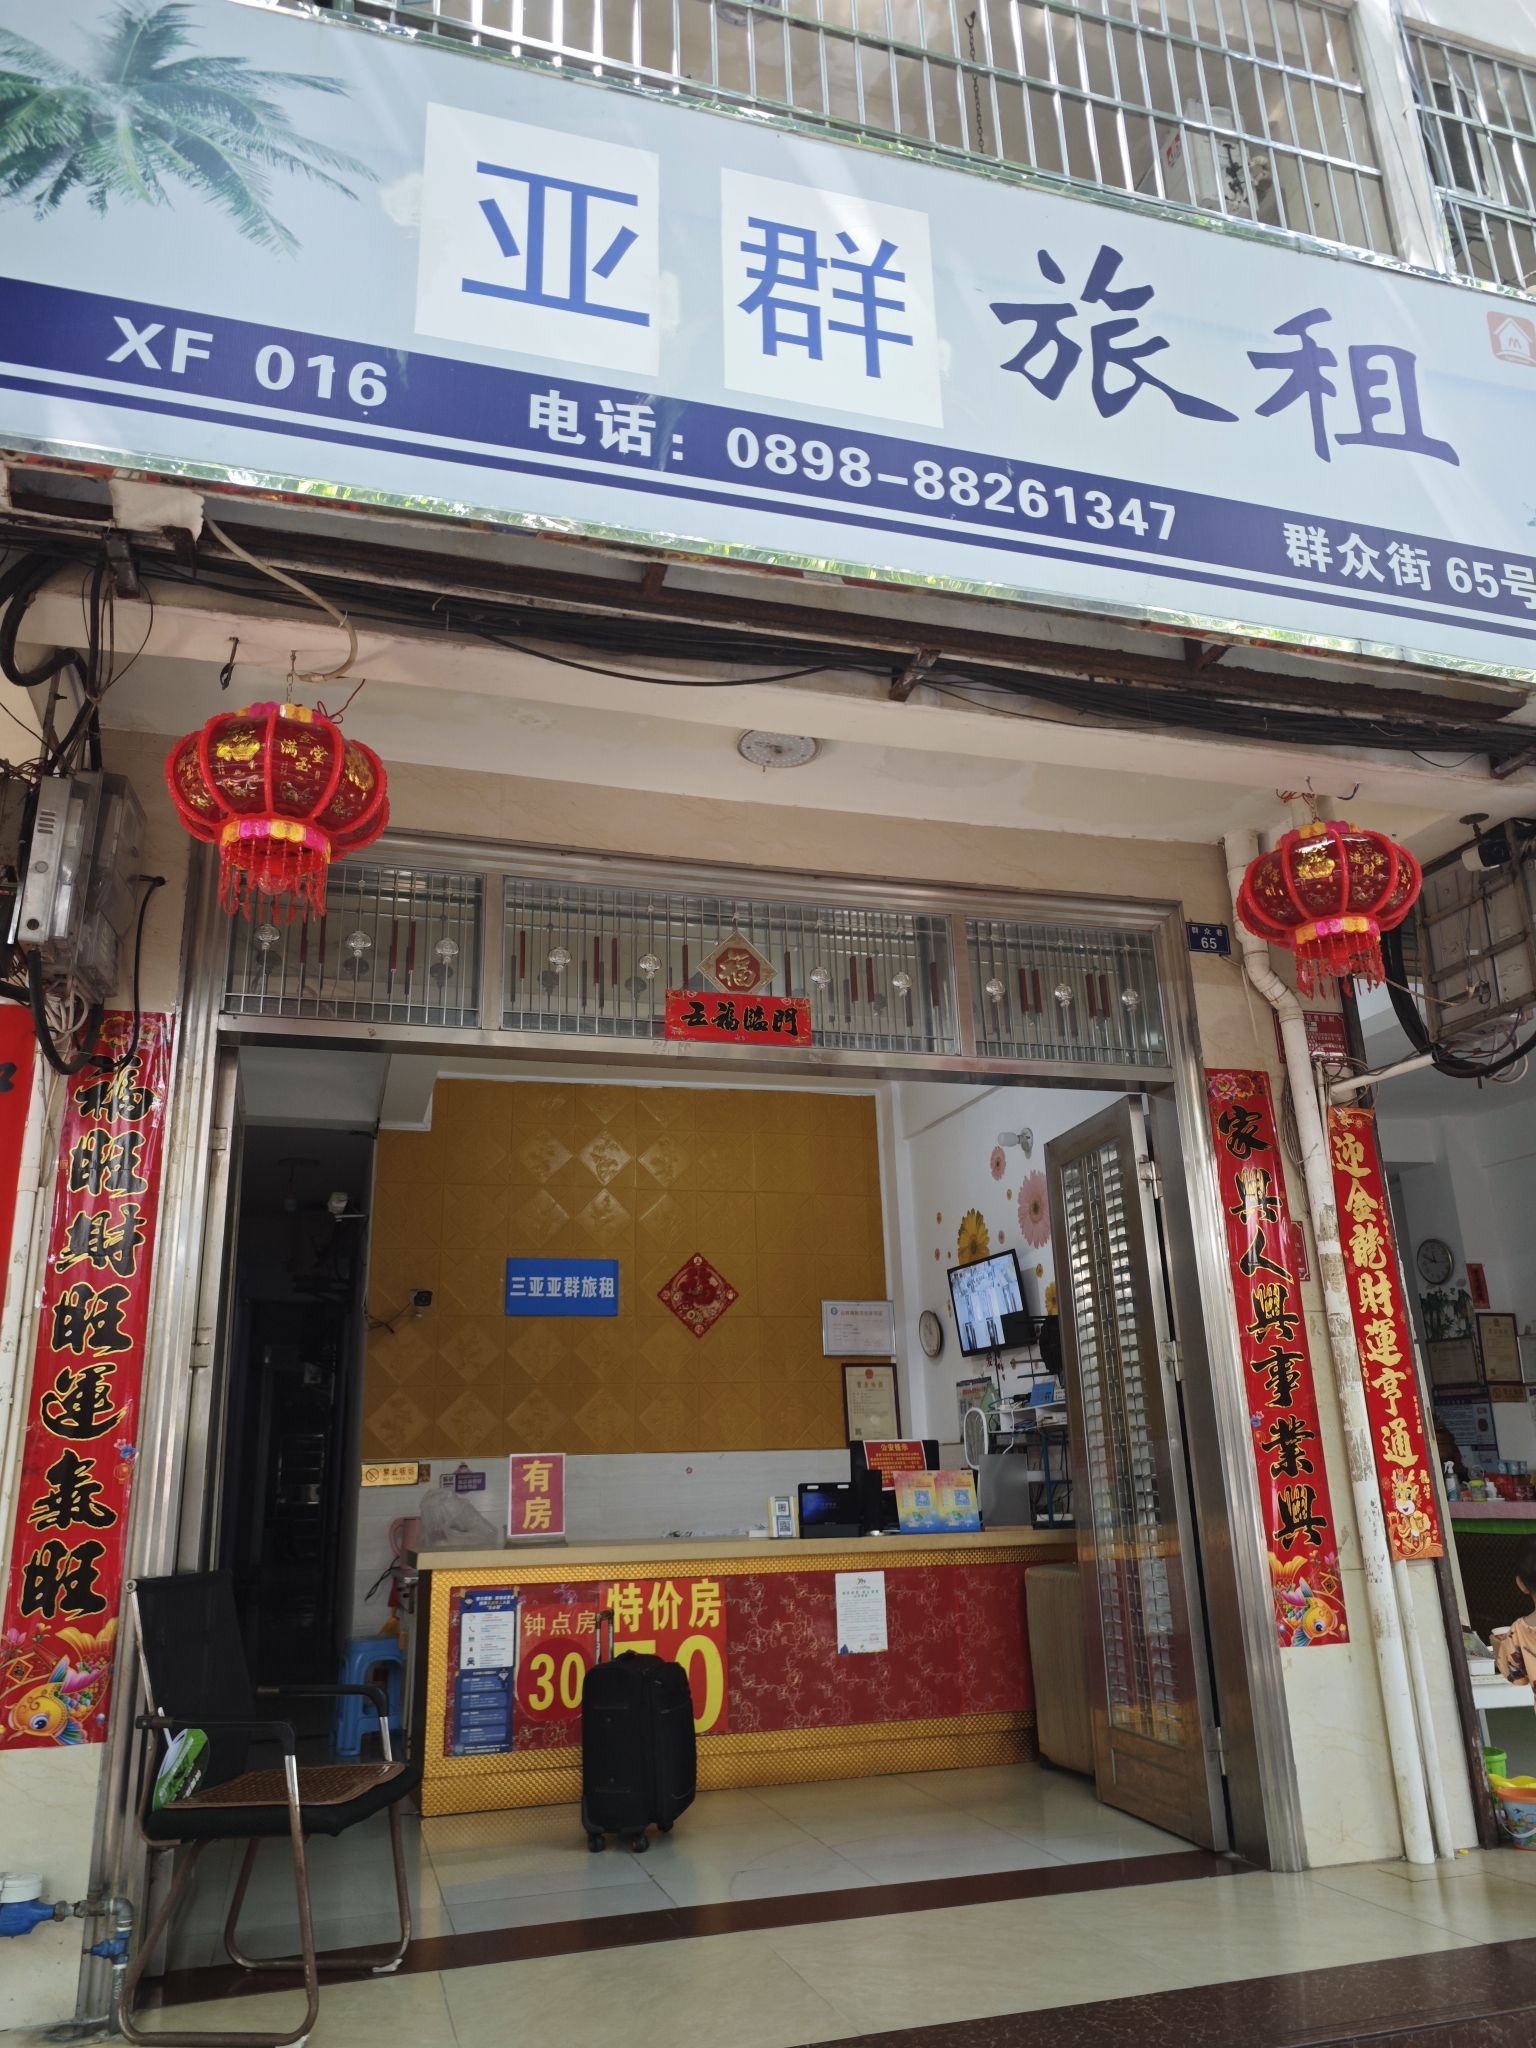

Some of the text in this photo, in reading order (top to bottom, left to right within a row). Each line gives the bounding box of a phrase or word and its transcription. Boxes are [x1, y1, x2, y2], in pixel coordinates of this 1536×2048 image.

[462, 160, 1460, 467] 亚群旅租
[106, 316, 389, 406] XF 016
[726, 426, 1177, 542] 0898-88261347
[718, 949, 757, 988] 福
[1201, 937, 1217, 949] 65
[510, 1276, 615, 1298] 三亚亚群旅租
[522, 1460, 553, 1530] 有房
[524, 1610, 598, 1637] 钟点房
[607, 1578, 722, 1633] 特价房
[528, 1652, 586, 1711] 30
[614, 1635, 724, 1734] 0
